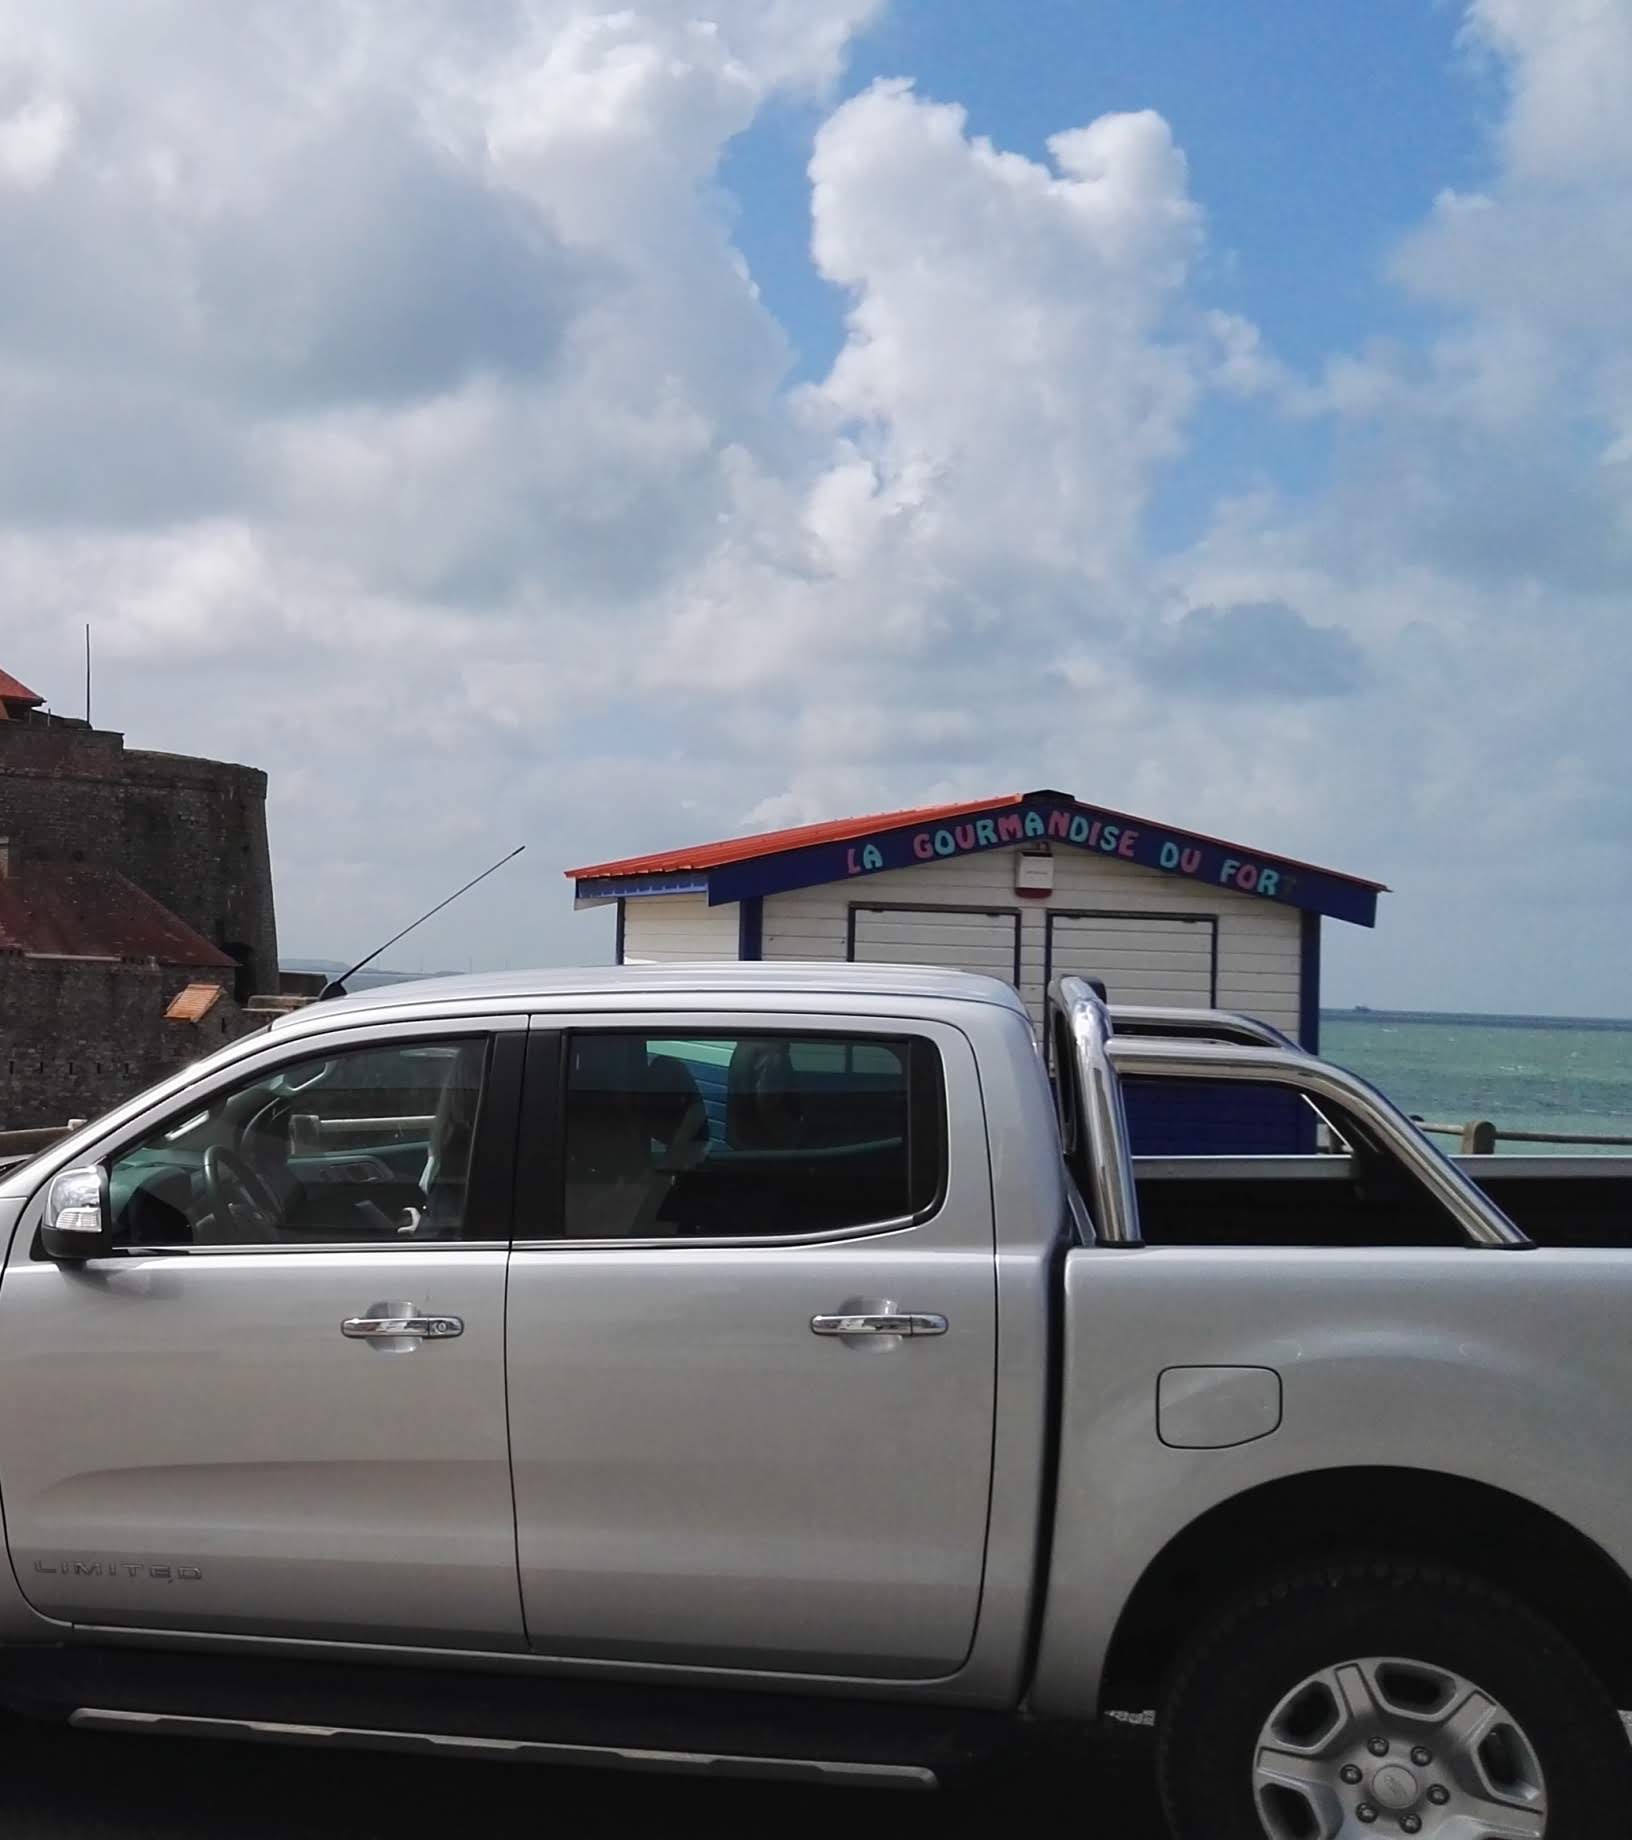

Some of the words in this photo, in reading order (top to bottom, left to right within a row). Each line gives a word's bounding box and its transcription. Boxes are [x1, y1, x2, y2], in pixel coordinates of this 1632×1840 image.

[847, 844, 884, 874] LA
[913, 810, 1140, 859] GOURMANDISE
[1159, 842, 1202, 873] DU
[33, 1559, 203, 1581] LIMITED
